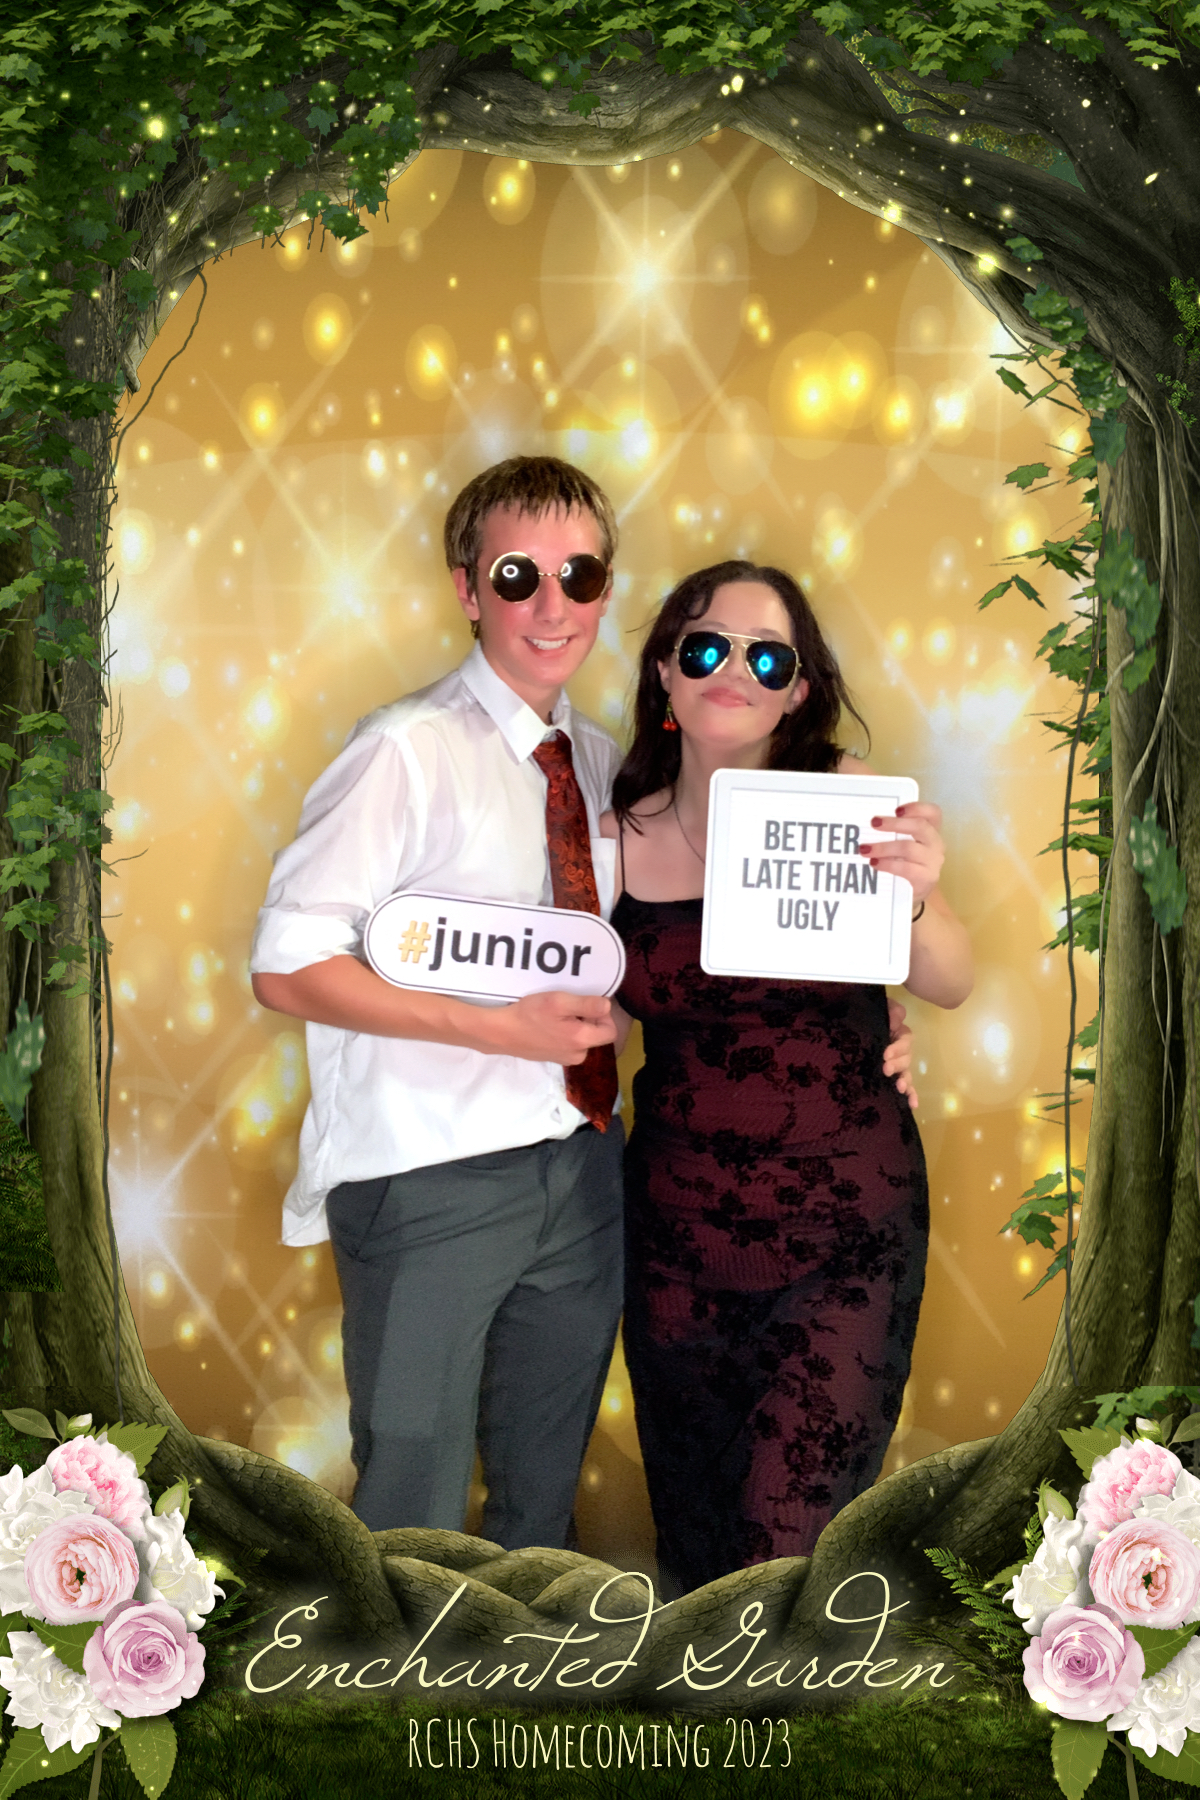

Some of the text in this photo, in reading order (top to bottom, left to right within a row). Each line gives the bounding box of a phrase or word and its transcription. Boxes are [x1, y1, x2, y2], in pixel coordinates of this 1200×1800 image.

[764, 820, 860, 855] BETTER
[742, 857, 878, 894] LATE THAN
[777, 898, 840, 931] UGLY
[398, 917, 592, 977] #junior
